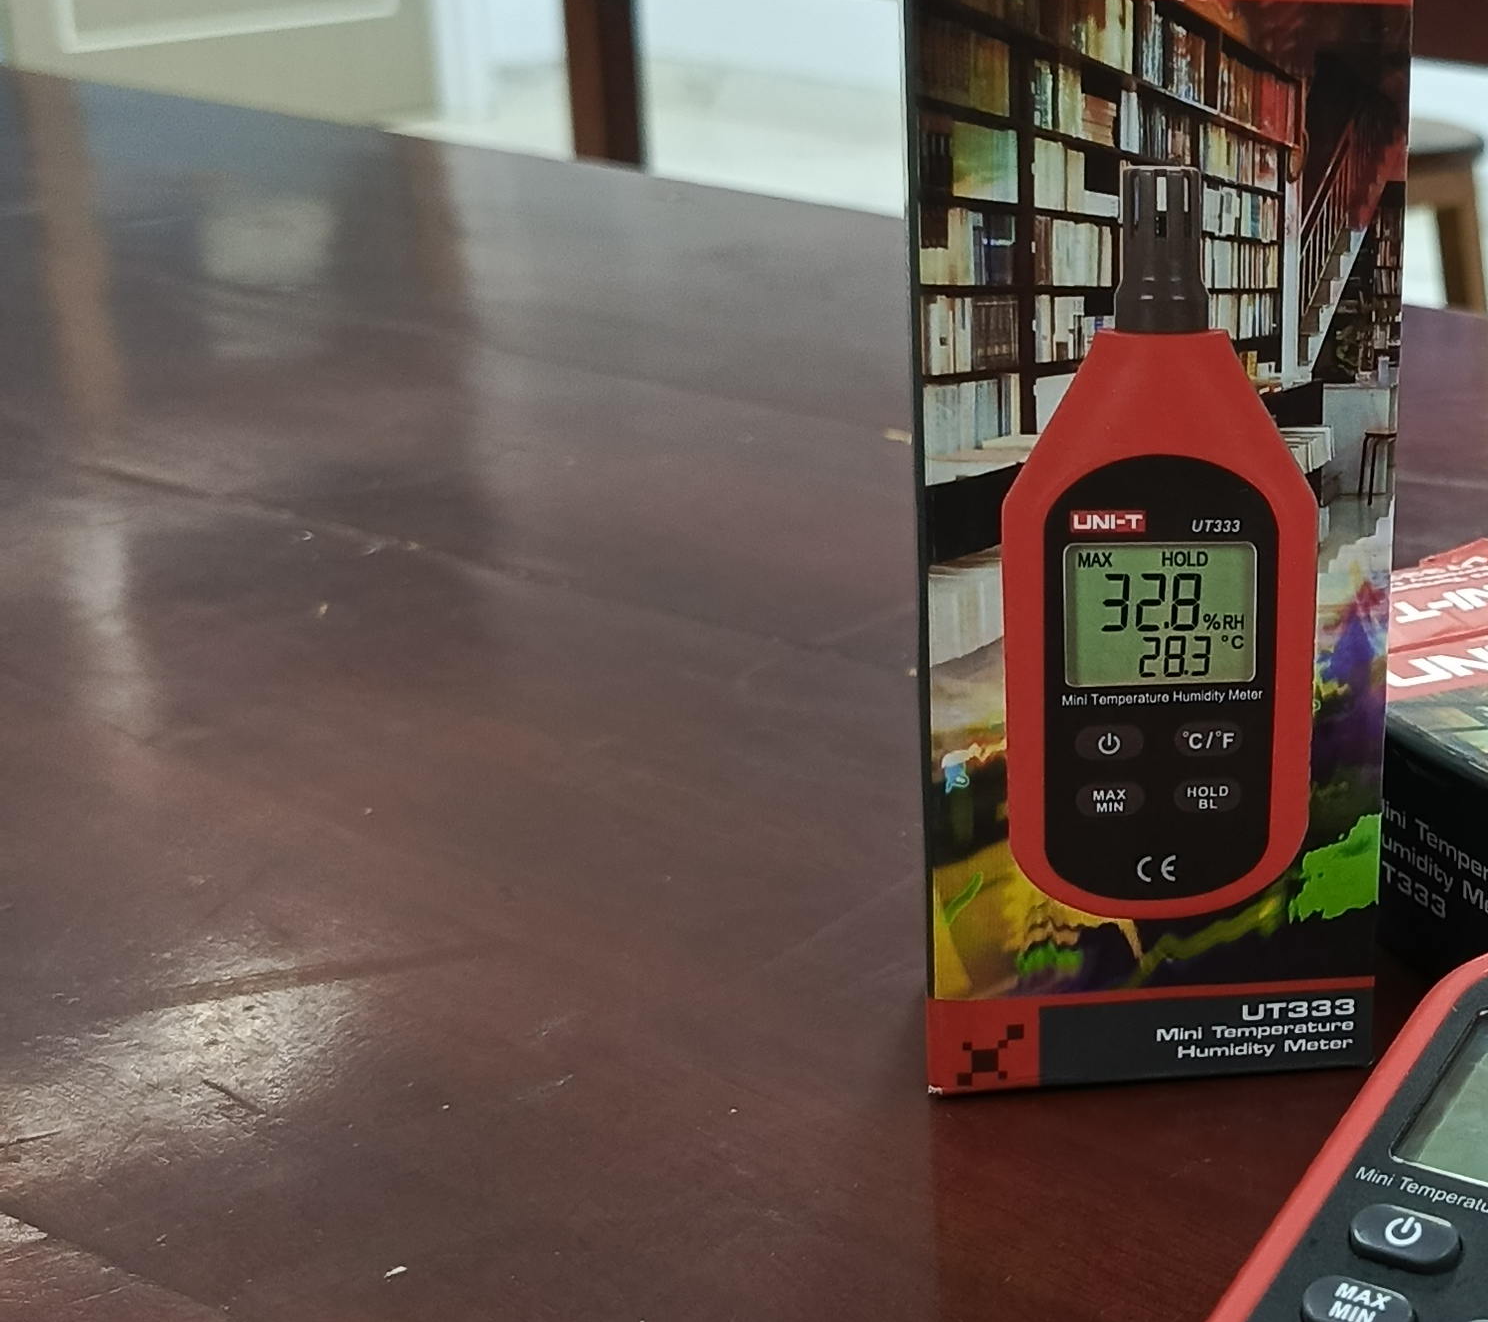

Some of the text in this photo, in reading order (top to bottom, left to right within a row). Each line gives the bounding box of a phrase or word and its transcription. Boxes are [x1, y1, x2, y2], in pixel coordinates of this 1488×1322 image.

[1072, 513, 1144, 530] UNI-T
[1191, 519, 1241, 533] UT333
[1077, 551, 1208, 568] MAX HOLD
[1138, 635, 1212, 677] 28.3
[1061, 688, 1263, 707] Mini Temperature Humidity Meter
[1092, 789, 1126, 801] MAX
[1186, 785, 1229, 798] HOLD
[1096, 800, 1124, 812] MIN
[1198, 798, 1218, 810] BL
[1382, 799, 1406, 829] ini
[1382, 833, 1453, 893] umidity
[1382, 860, 1446, 919] T333
[1242, 998, 1356, 1022] UT333
[1156, 1018, 1355, 1043] Mini Temperature
[1177, 1035, 1354, 1060] Humidity Meter
[1354, 1166, 1396, 1189] Mini
[1335, 1282, 1392, 1311] MAX
